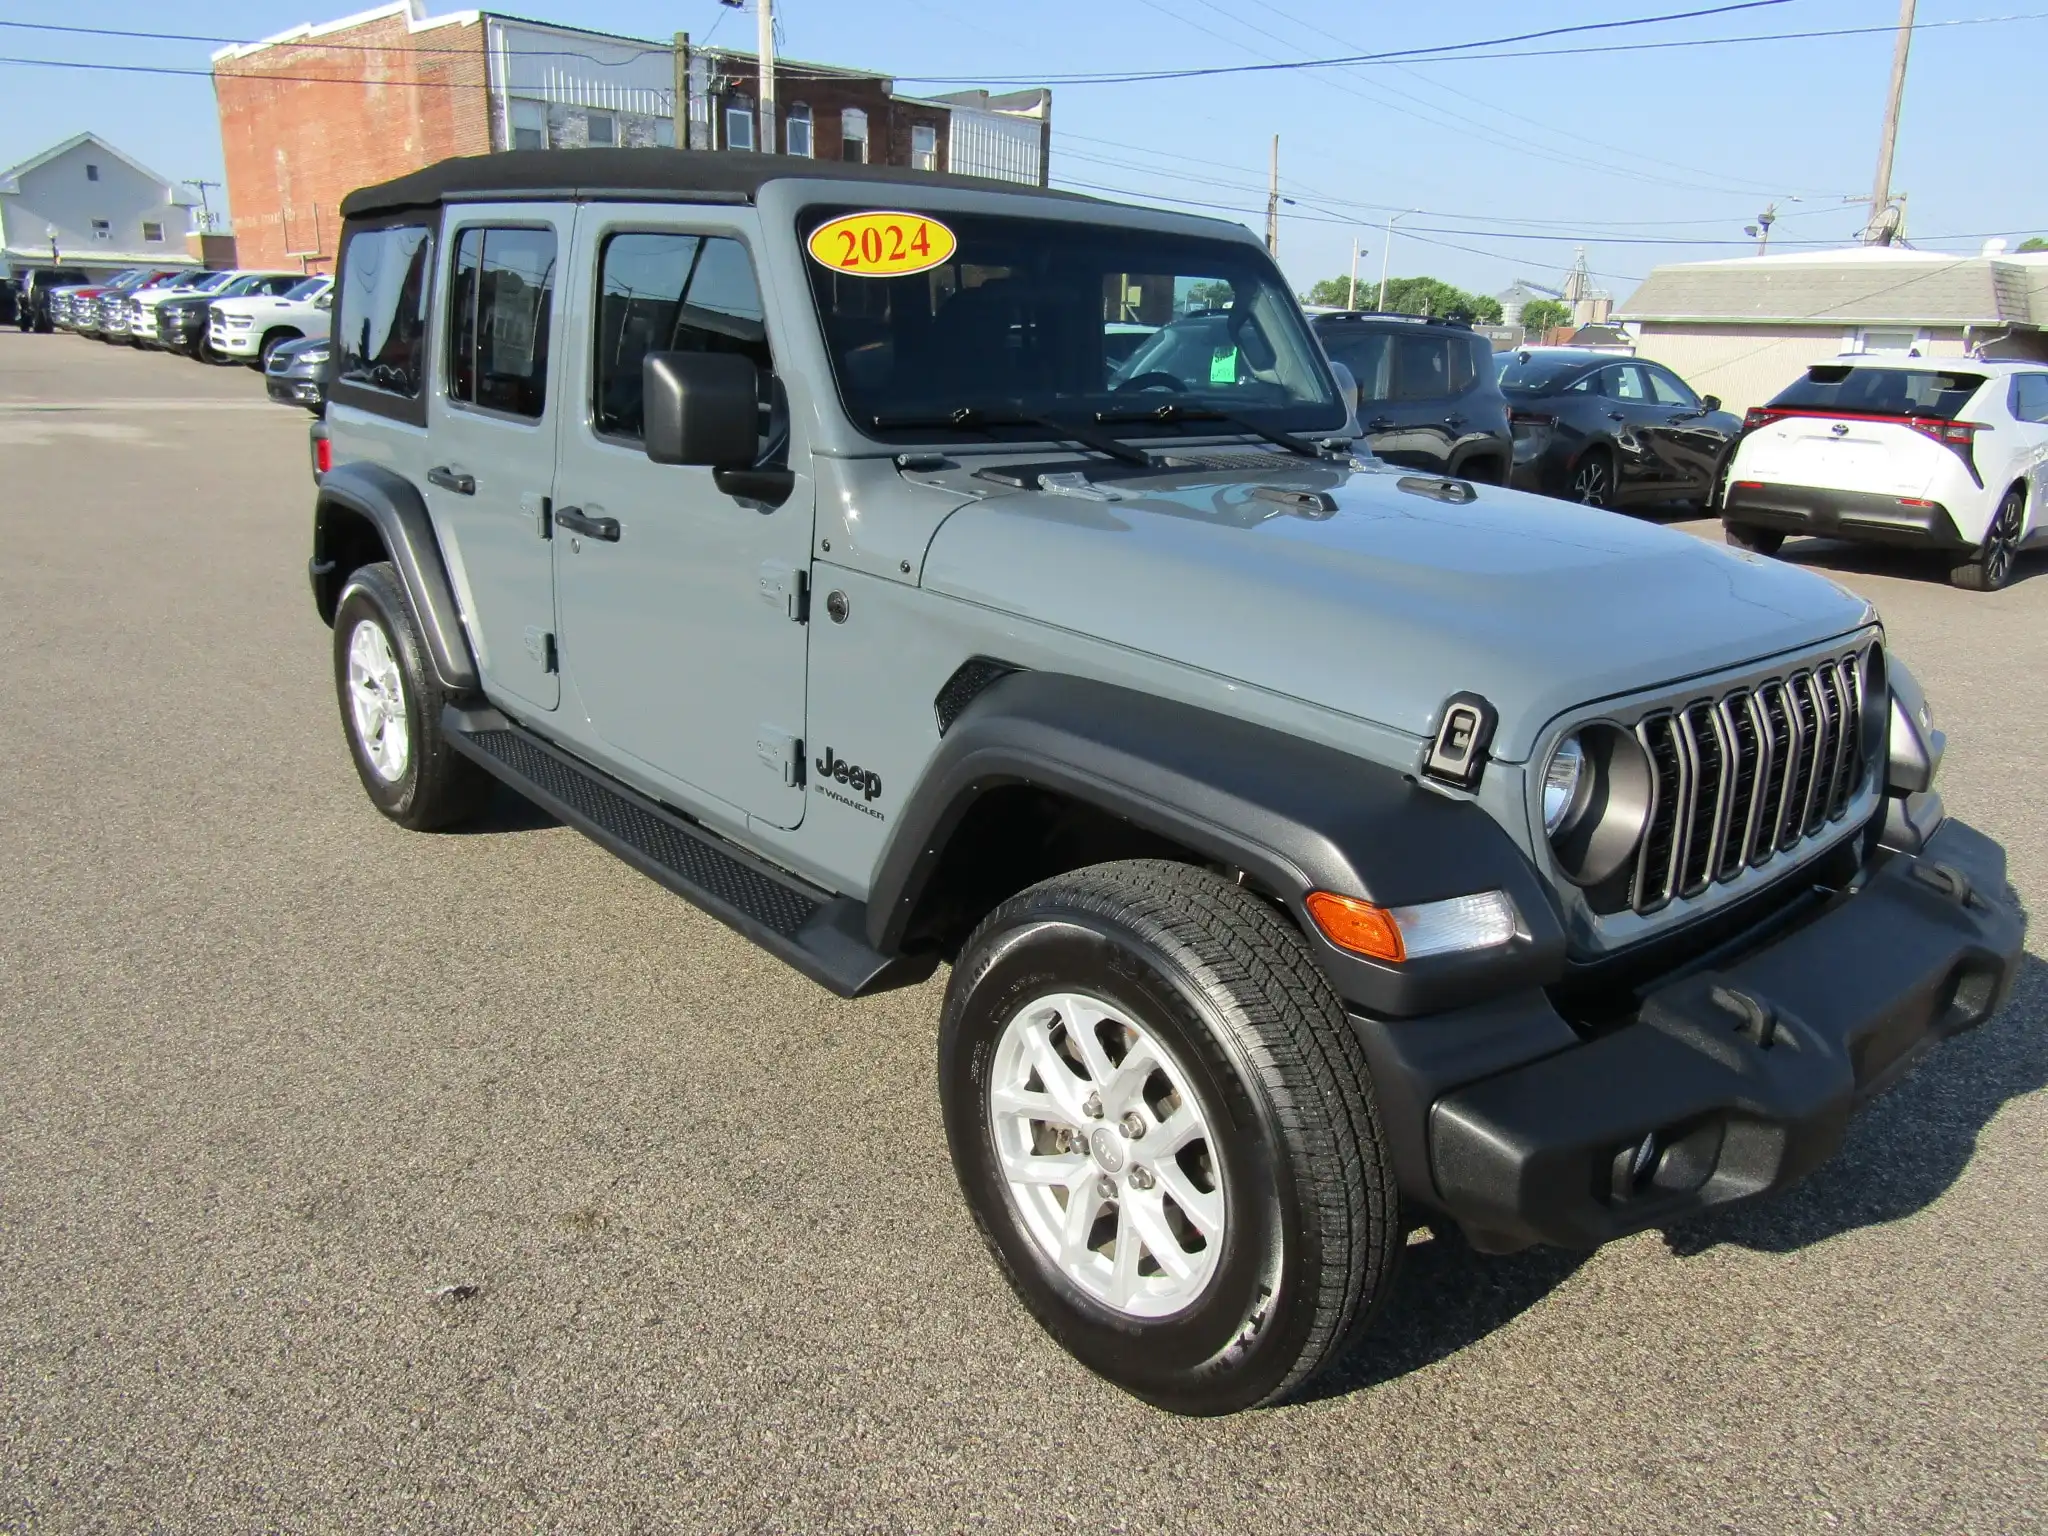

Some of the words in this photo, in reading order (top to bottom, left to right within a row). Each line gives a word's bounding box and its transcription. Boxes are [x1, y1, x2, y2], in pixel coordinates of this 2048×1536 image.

[838, 222, 931, 267] 2024
[816, 746, 882, 802] Jeep
[826, 789, 885, 821] WRANGLER
